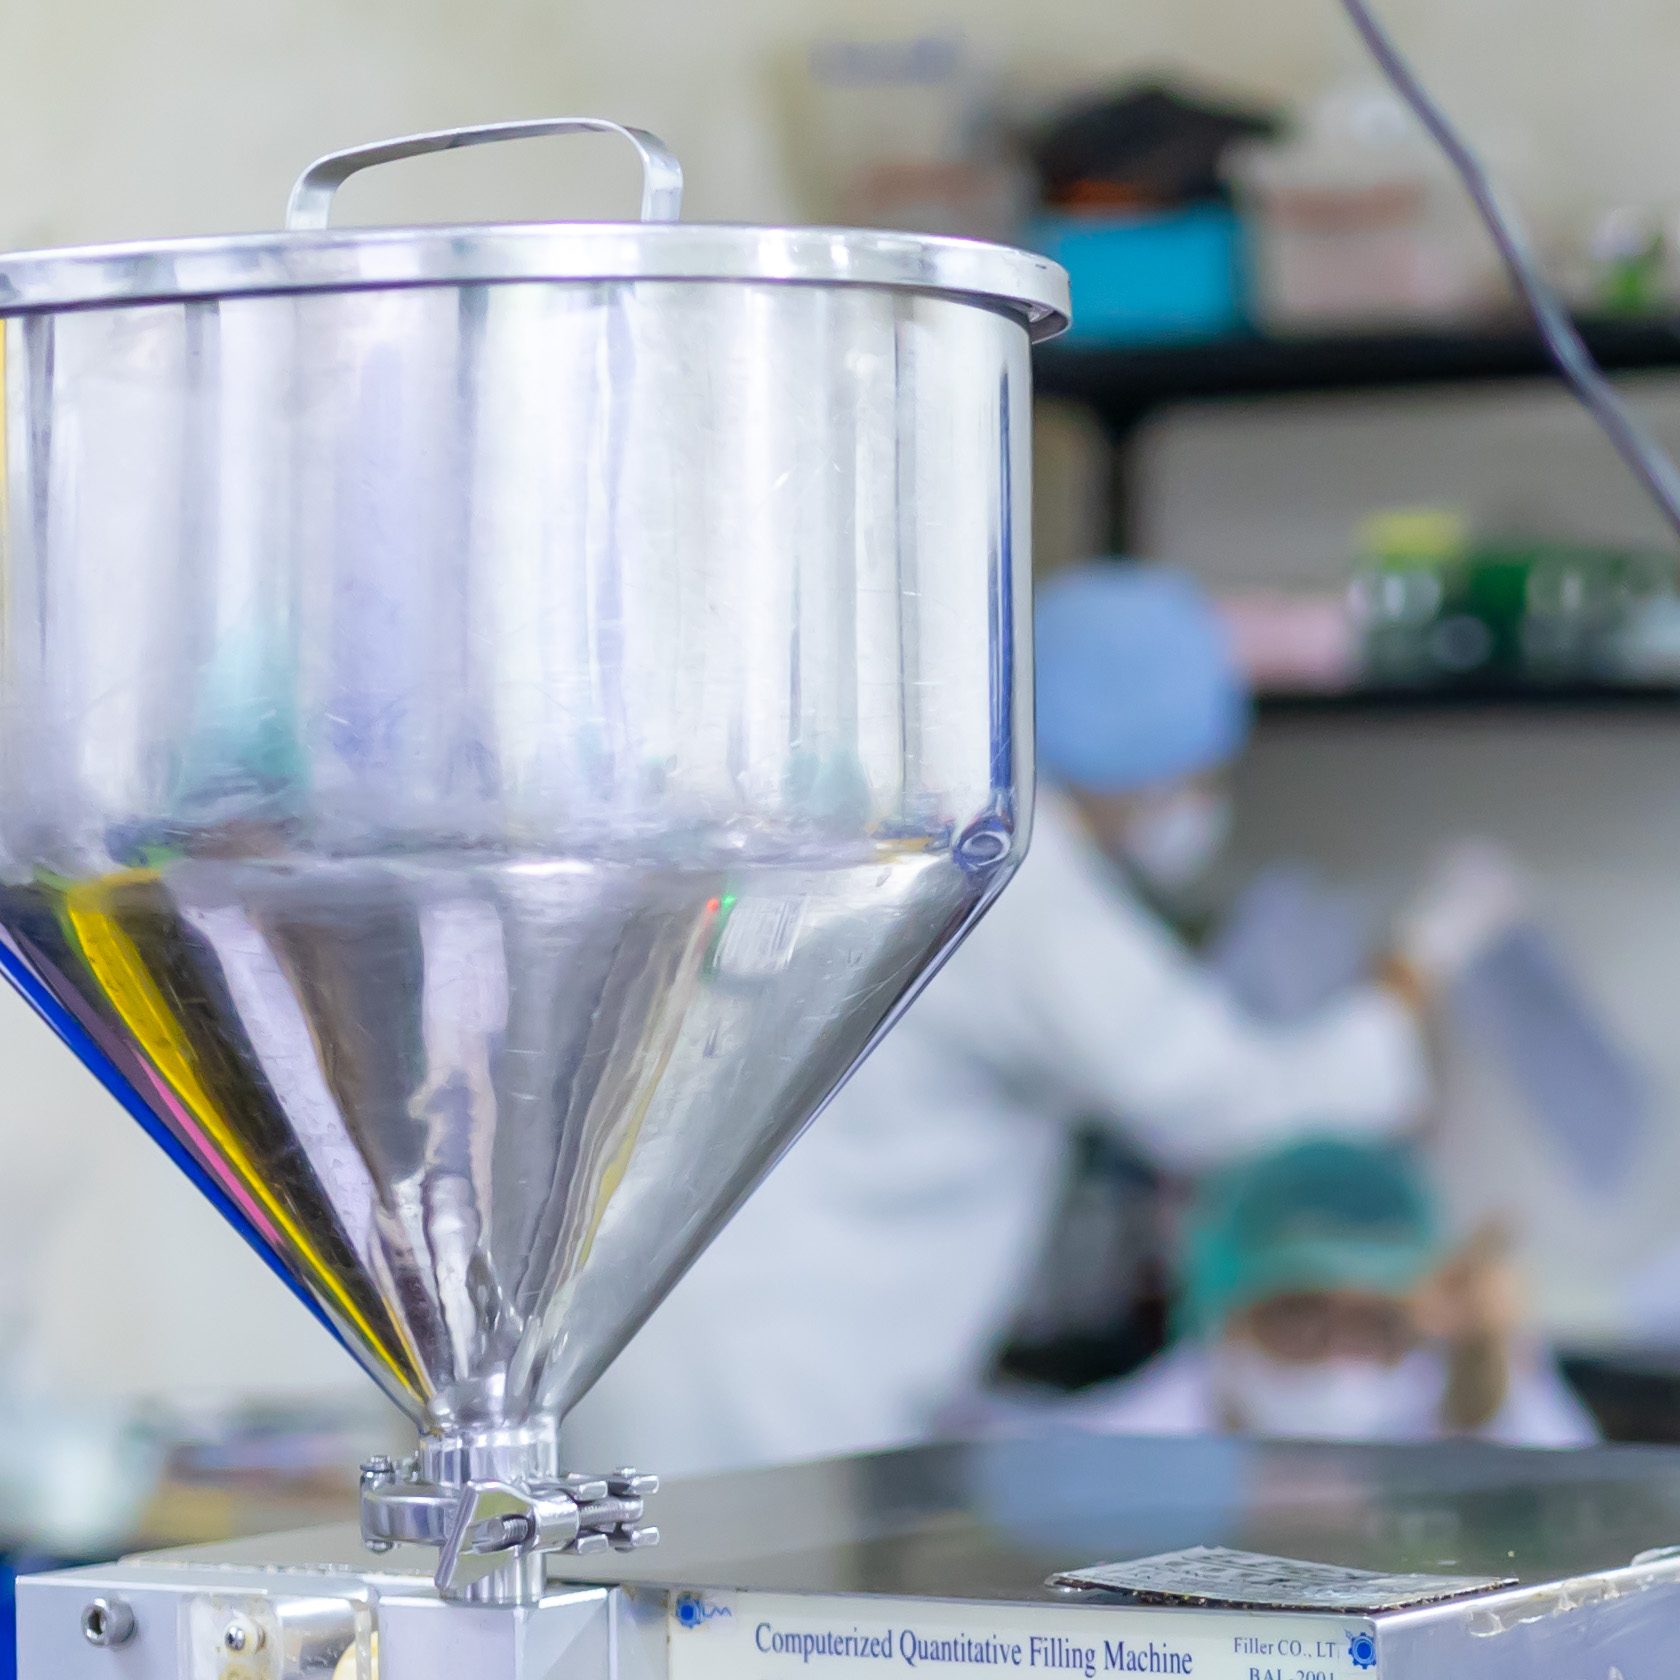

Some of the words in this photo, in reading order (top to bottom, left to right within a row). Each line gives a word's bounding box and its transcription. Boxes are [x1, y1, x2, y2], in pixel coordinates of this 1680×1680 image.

[755, 1622, 893, 1663] Computerized
[899, 1629, 1022, 1668] Quantitative
[1029, 1636, 1096, 1678] Filling
[1103, 1640, 1193, 1675] Machine
[1234, 1636, 1274, 1656] Filler
